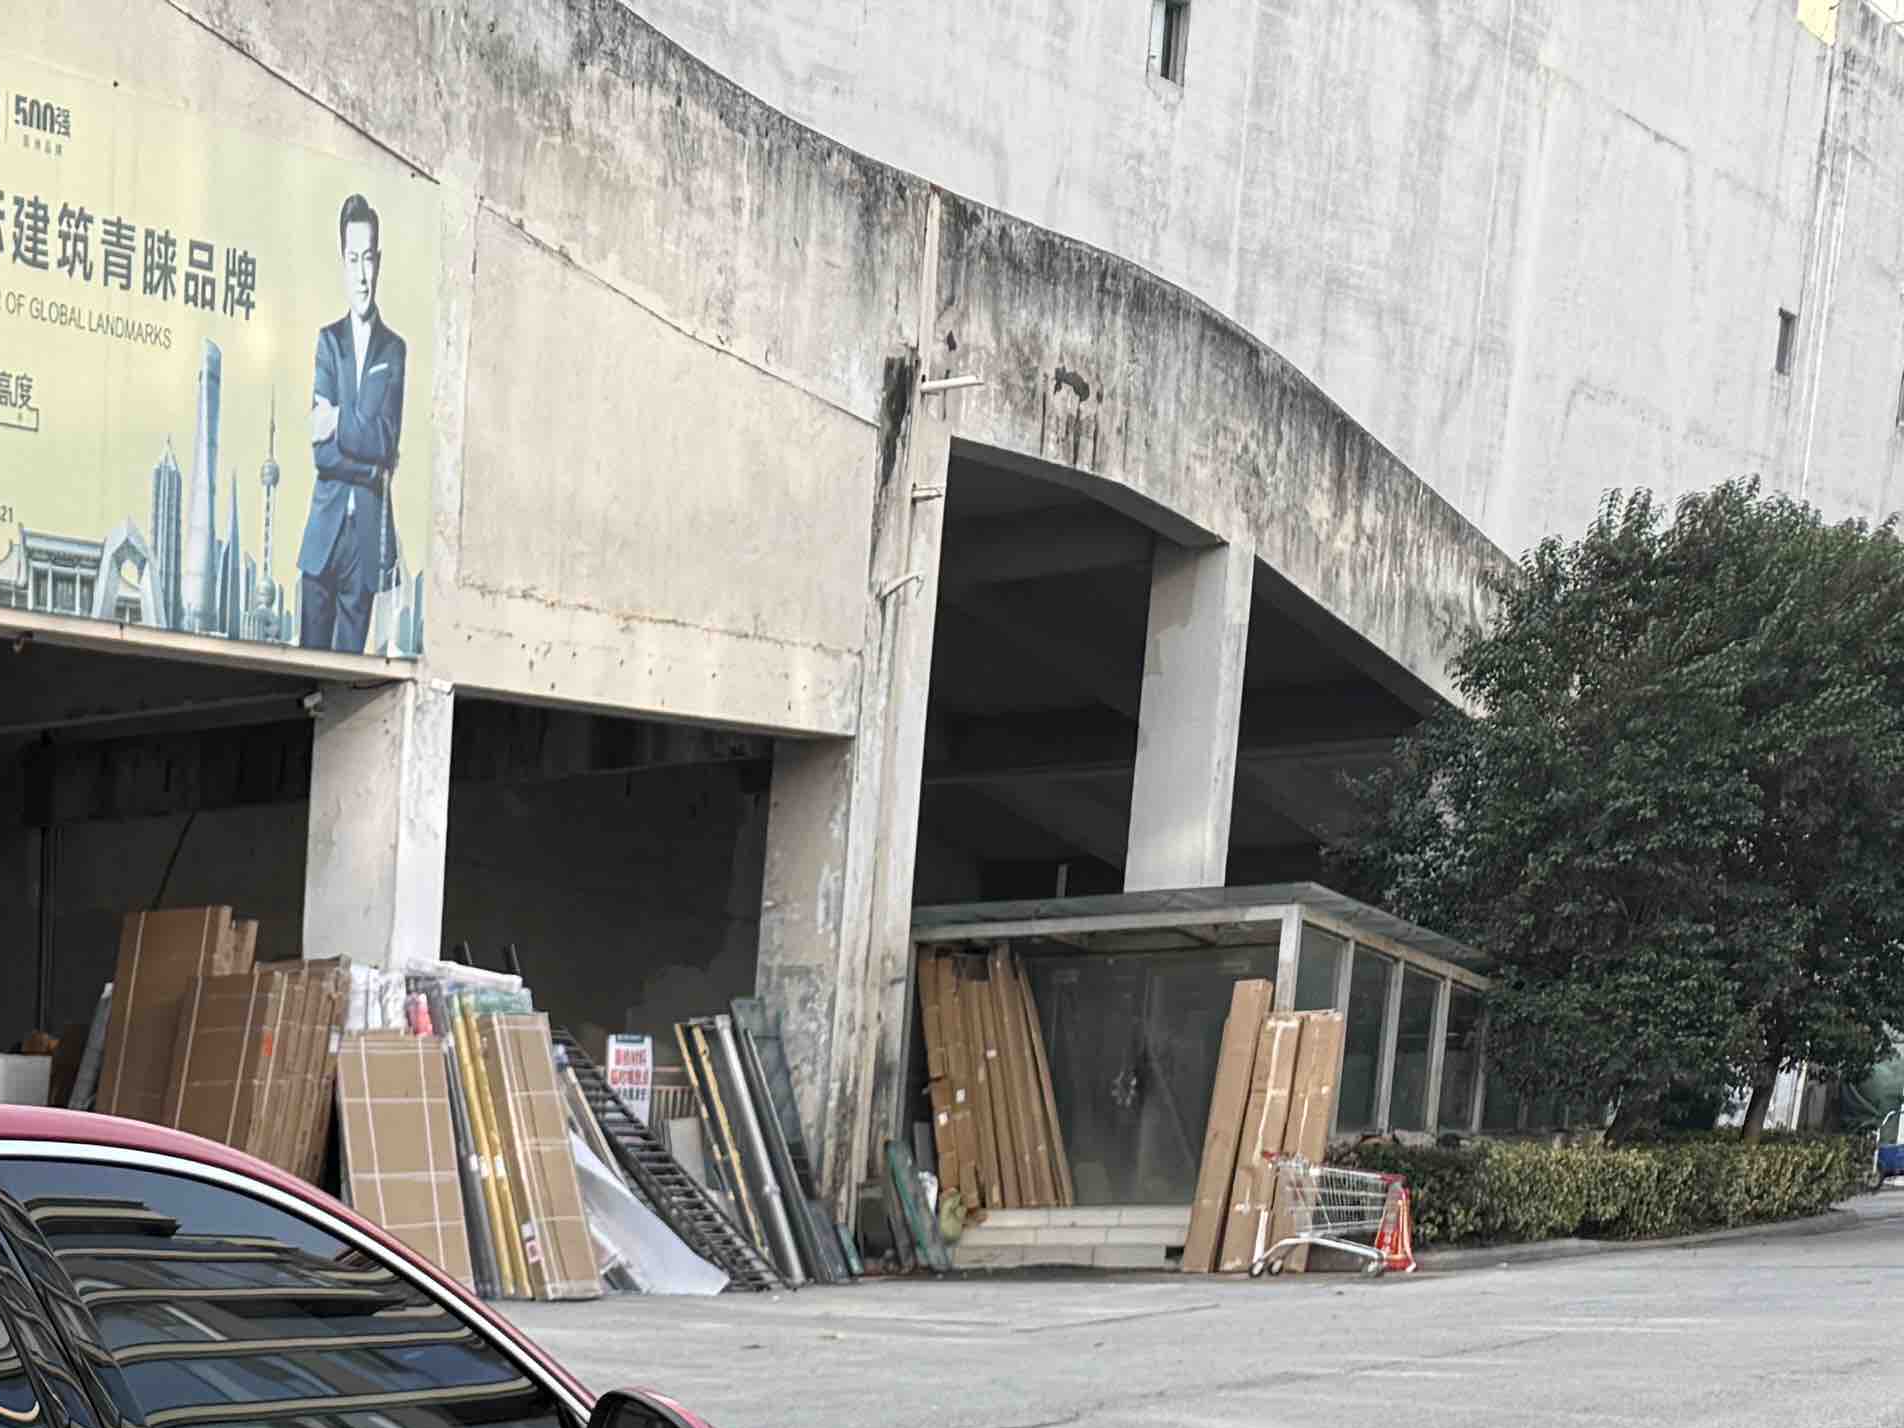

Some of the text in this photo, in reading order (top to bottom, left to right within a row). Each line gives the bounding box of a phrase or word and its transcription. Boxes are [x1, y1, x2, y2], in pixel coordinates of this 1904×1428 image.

[5, 290, 26, 315] OF
[30, 296, 86, 330] GLOBAL
[88, 312, 172, 350] LANDMARKS
